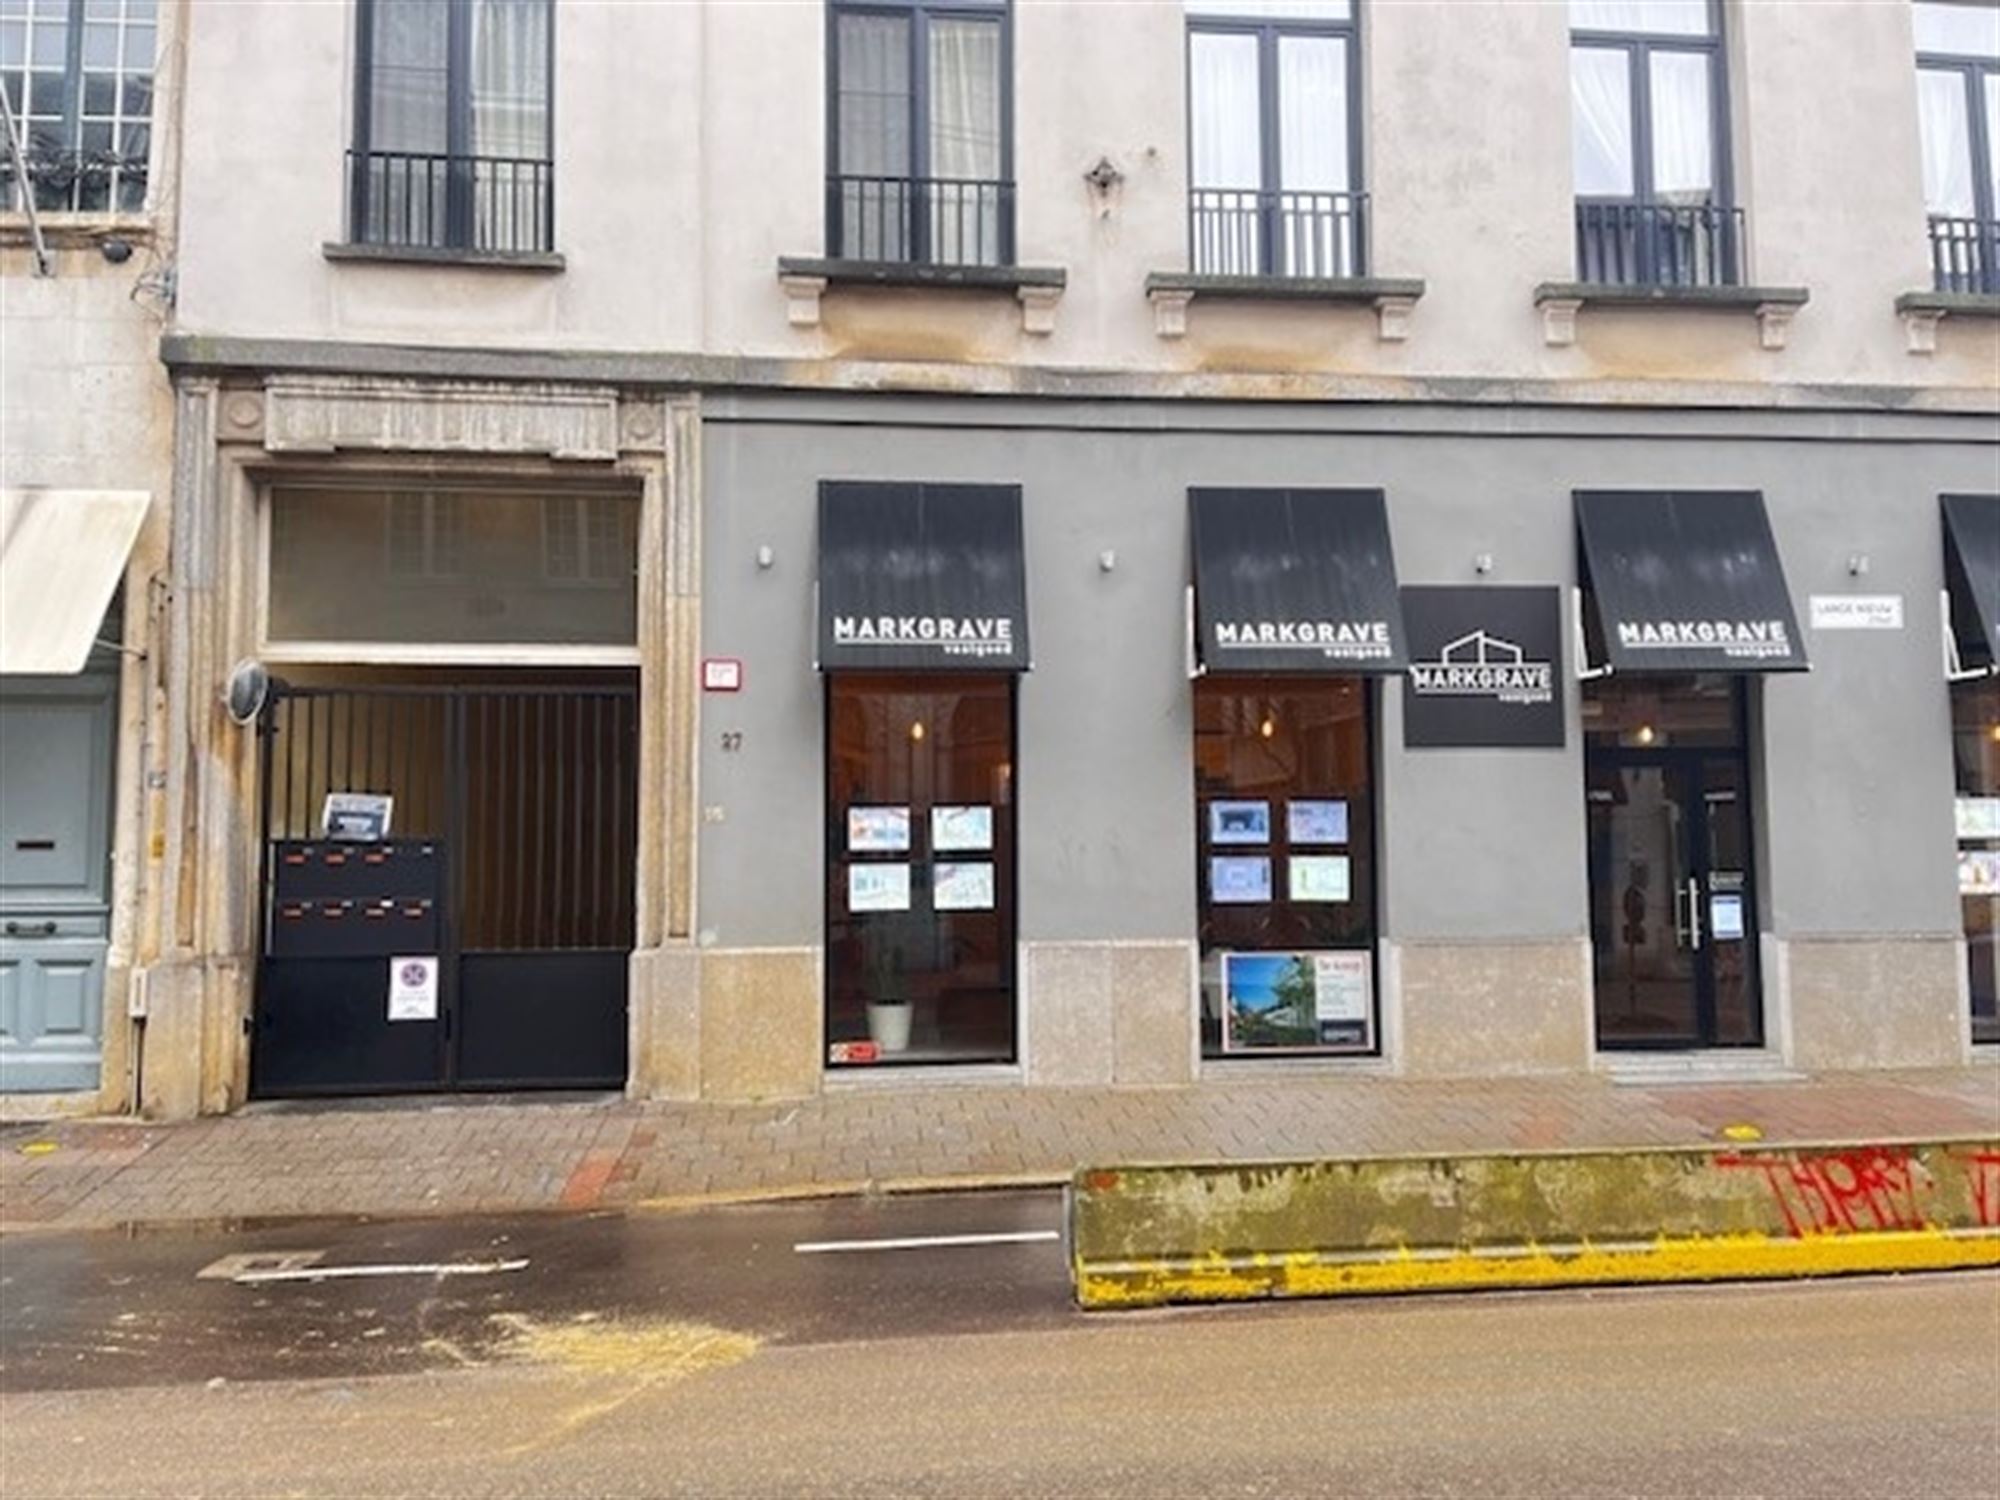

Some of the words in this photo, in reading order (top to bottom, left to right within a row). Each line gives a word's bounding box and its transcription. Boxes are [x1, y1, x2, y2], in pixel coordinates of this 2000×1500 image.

[833, 616, 1012, 639] MARKGRAVE
[1215, 622, 1390, 643] MARKGRAVE
[1617, 621, 1788, 643] MARKGRAVE
[1413, 667, 1551, 689] MARKGRAVE
